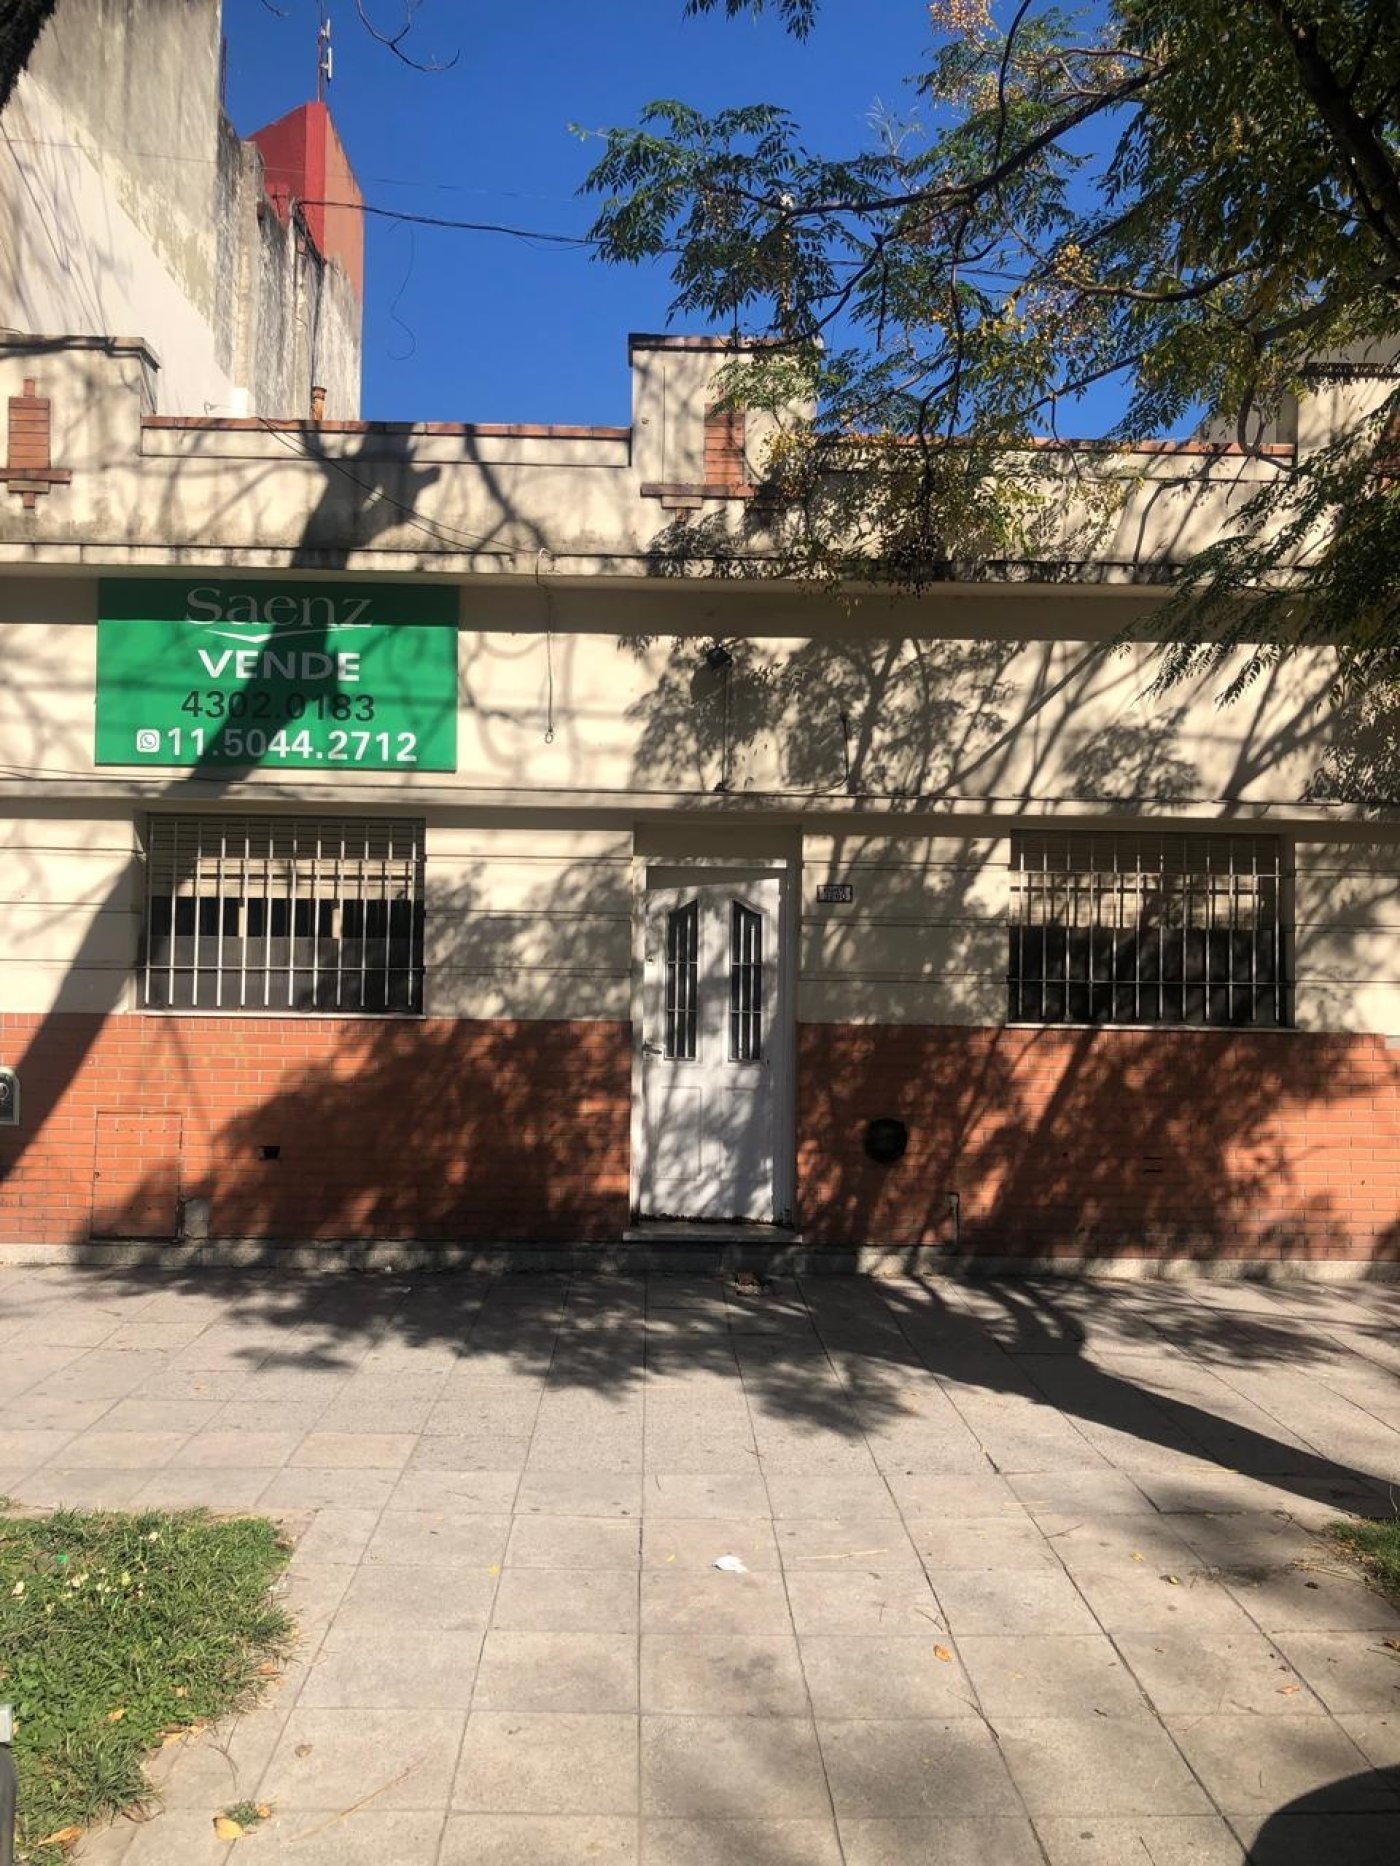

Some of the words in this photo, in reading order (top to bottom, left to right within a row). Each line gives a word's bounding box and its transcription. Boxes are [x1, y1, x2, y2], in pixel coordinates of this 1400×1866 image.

[186, 586, 374, 627] Saenz
[198, 649, 361, 682] VENDE
[181, 690, 375, 721] 4302.0183
[168, 727, 418, 762] 11.5044.2712
